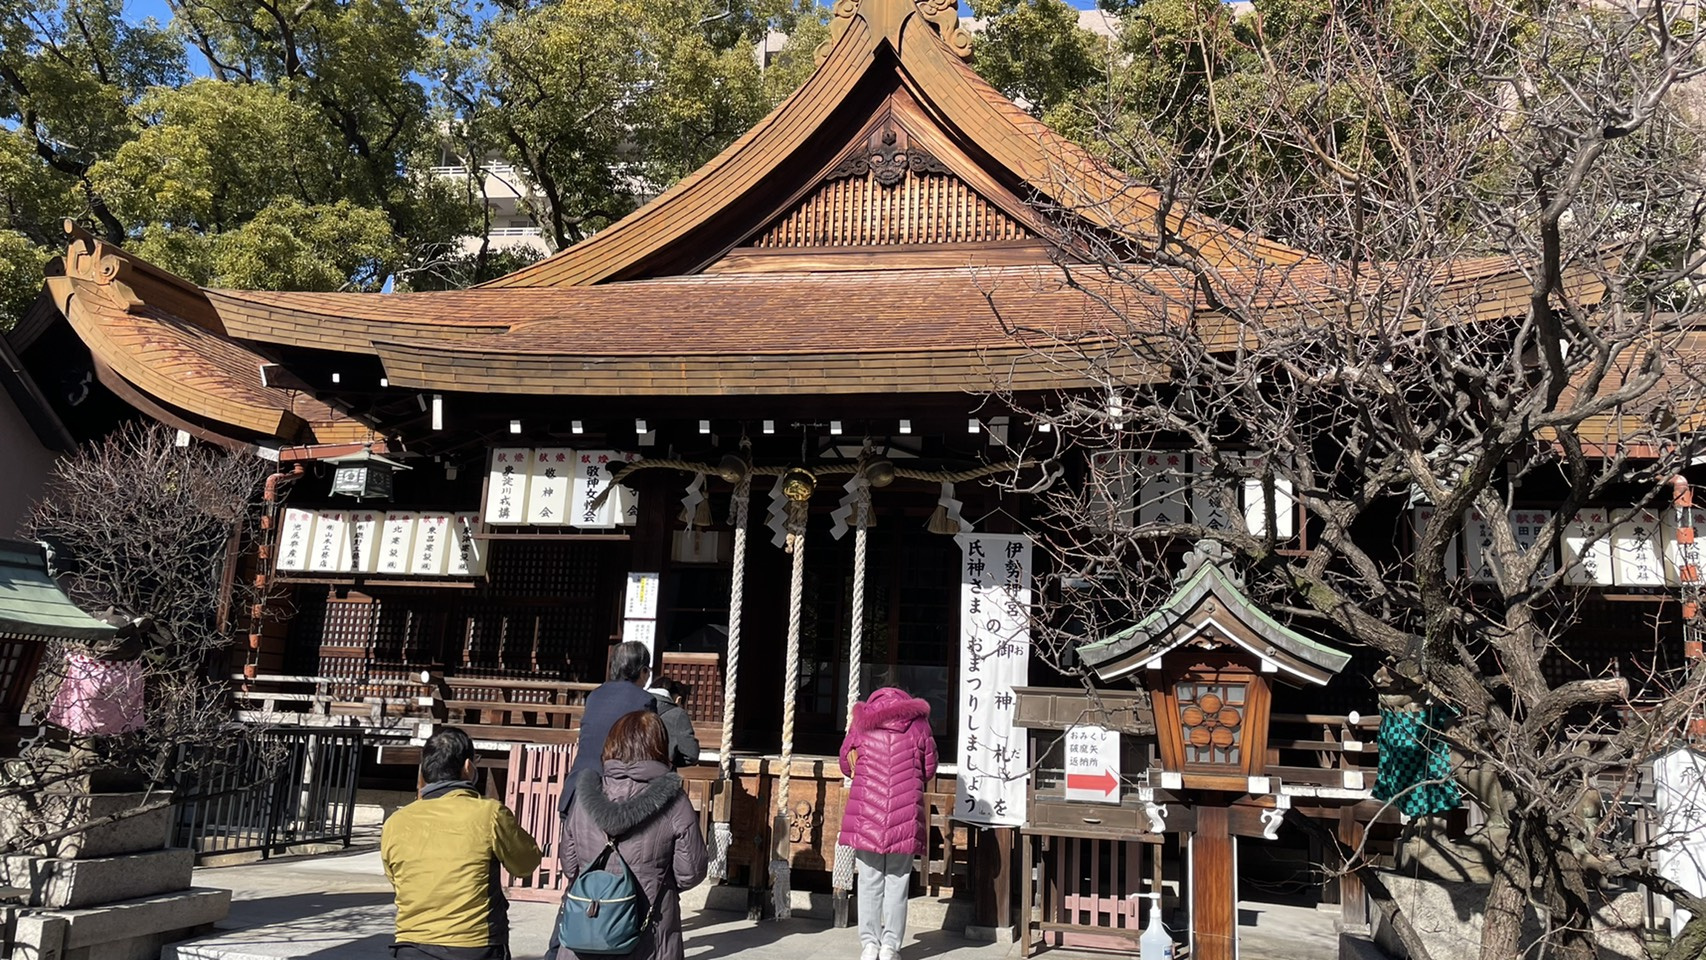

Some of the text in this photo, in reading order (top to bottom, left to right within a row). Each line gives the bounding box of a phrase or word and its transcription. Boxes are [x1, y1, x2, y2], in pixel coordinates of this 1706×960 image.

[539, 453, 566, 462] 献燈
[1147, 455, 1179, 466] 献燈
[539, 468, 556, 518] 敬神会
[966, 541, 986, 614] 氏神さま
[1004, 541, 1024, 618] 伊勢神宮
[987, 618, 1001, 634] の
[964, 637, 983, 814] おまつりしましょう
[1070, 732, 1107, 741] おみくじ
[1070, 744, 1098, 754] 破魔矢
[1070, 756, 1098, 767] 返納所
